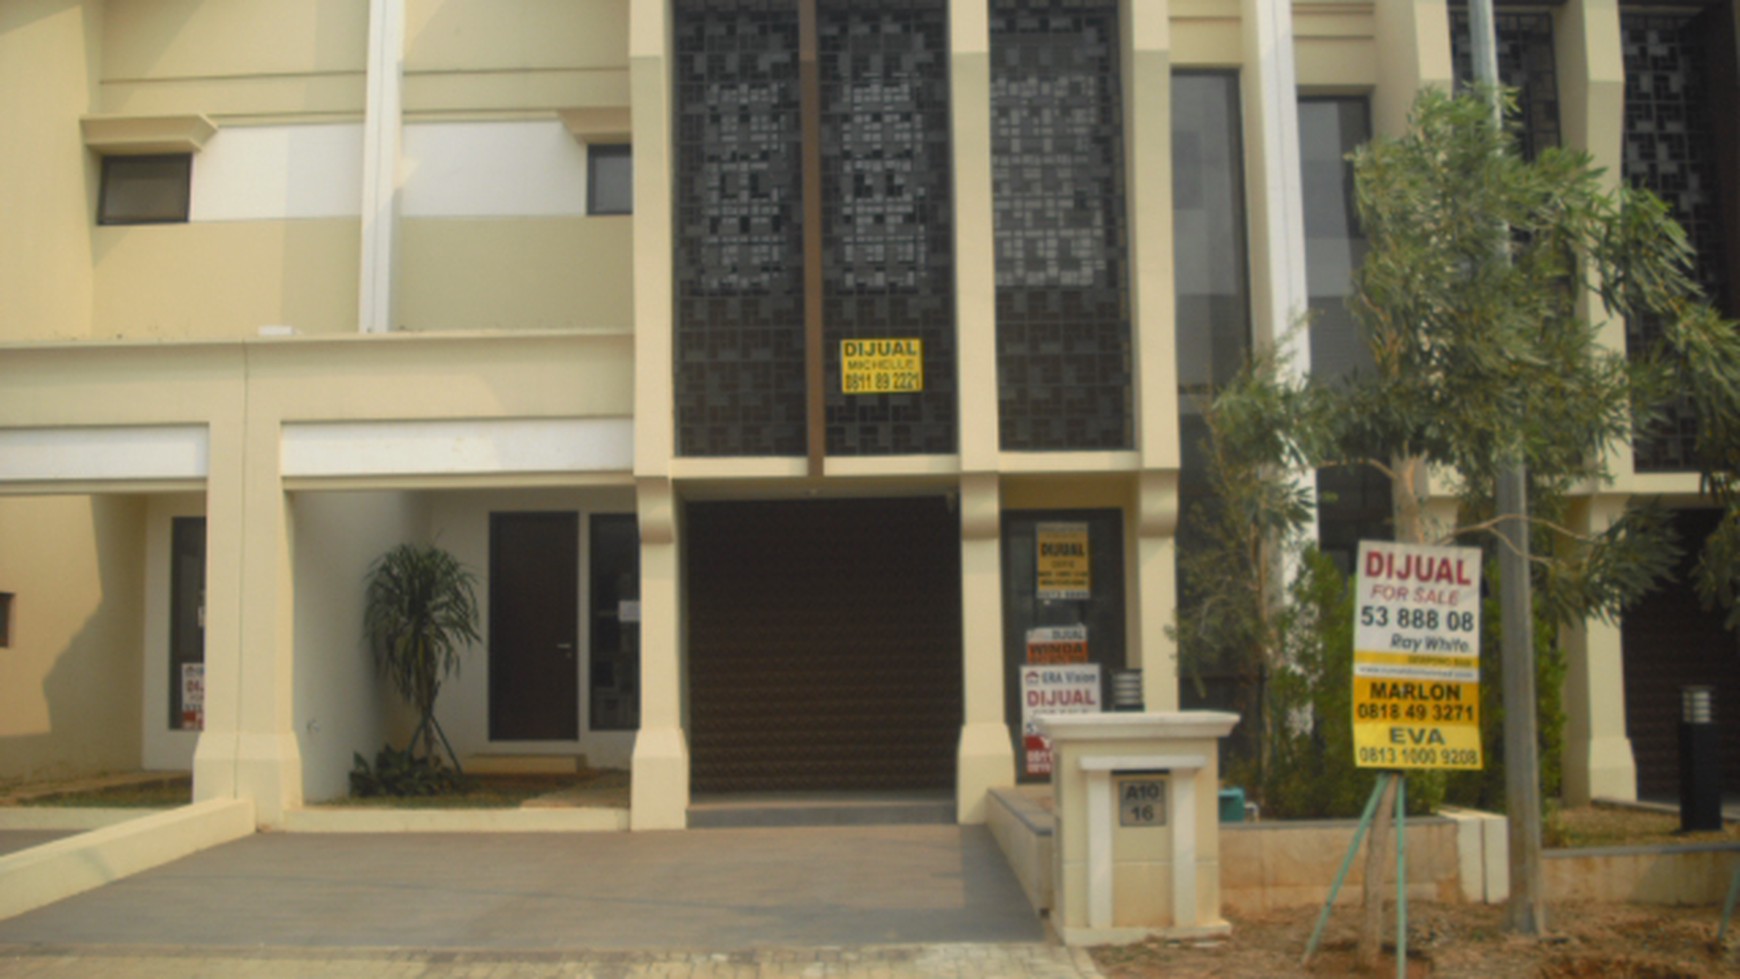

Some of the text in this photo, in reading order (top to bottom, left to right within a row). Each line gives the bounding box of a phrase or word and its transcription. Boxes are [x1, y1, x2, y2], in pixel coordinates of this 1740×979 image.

[845, 341, 917, 357] DIJUAL
[1041, 543, 1085, 557] DIJUAL
[1366, 551, 1472, 586] DIJUAL
[1370, 584, 1459, 606] FOR SALE
[1361, 605, 1474, 632] 53 888 08
[1391, 633, 1469, 653] Ray White
[1042, 672, 1063, 684] ERA
[1027, 689, 1095, 708] DIJUAL
[1370, 682, 1461, 701] MARLON
[1358, 703, 1474, 721] 0818 49 3271
[1390, 727, 1446, 744] EVA
[1360, 747, 1396, 763] 0813
[1125, 783, 1159, 799] A10
[1130, 804, 1155, 821] 16
